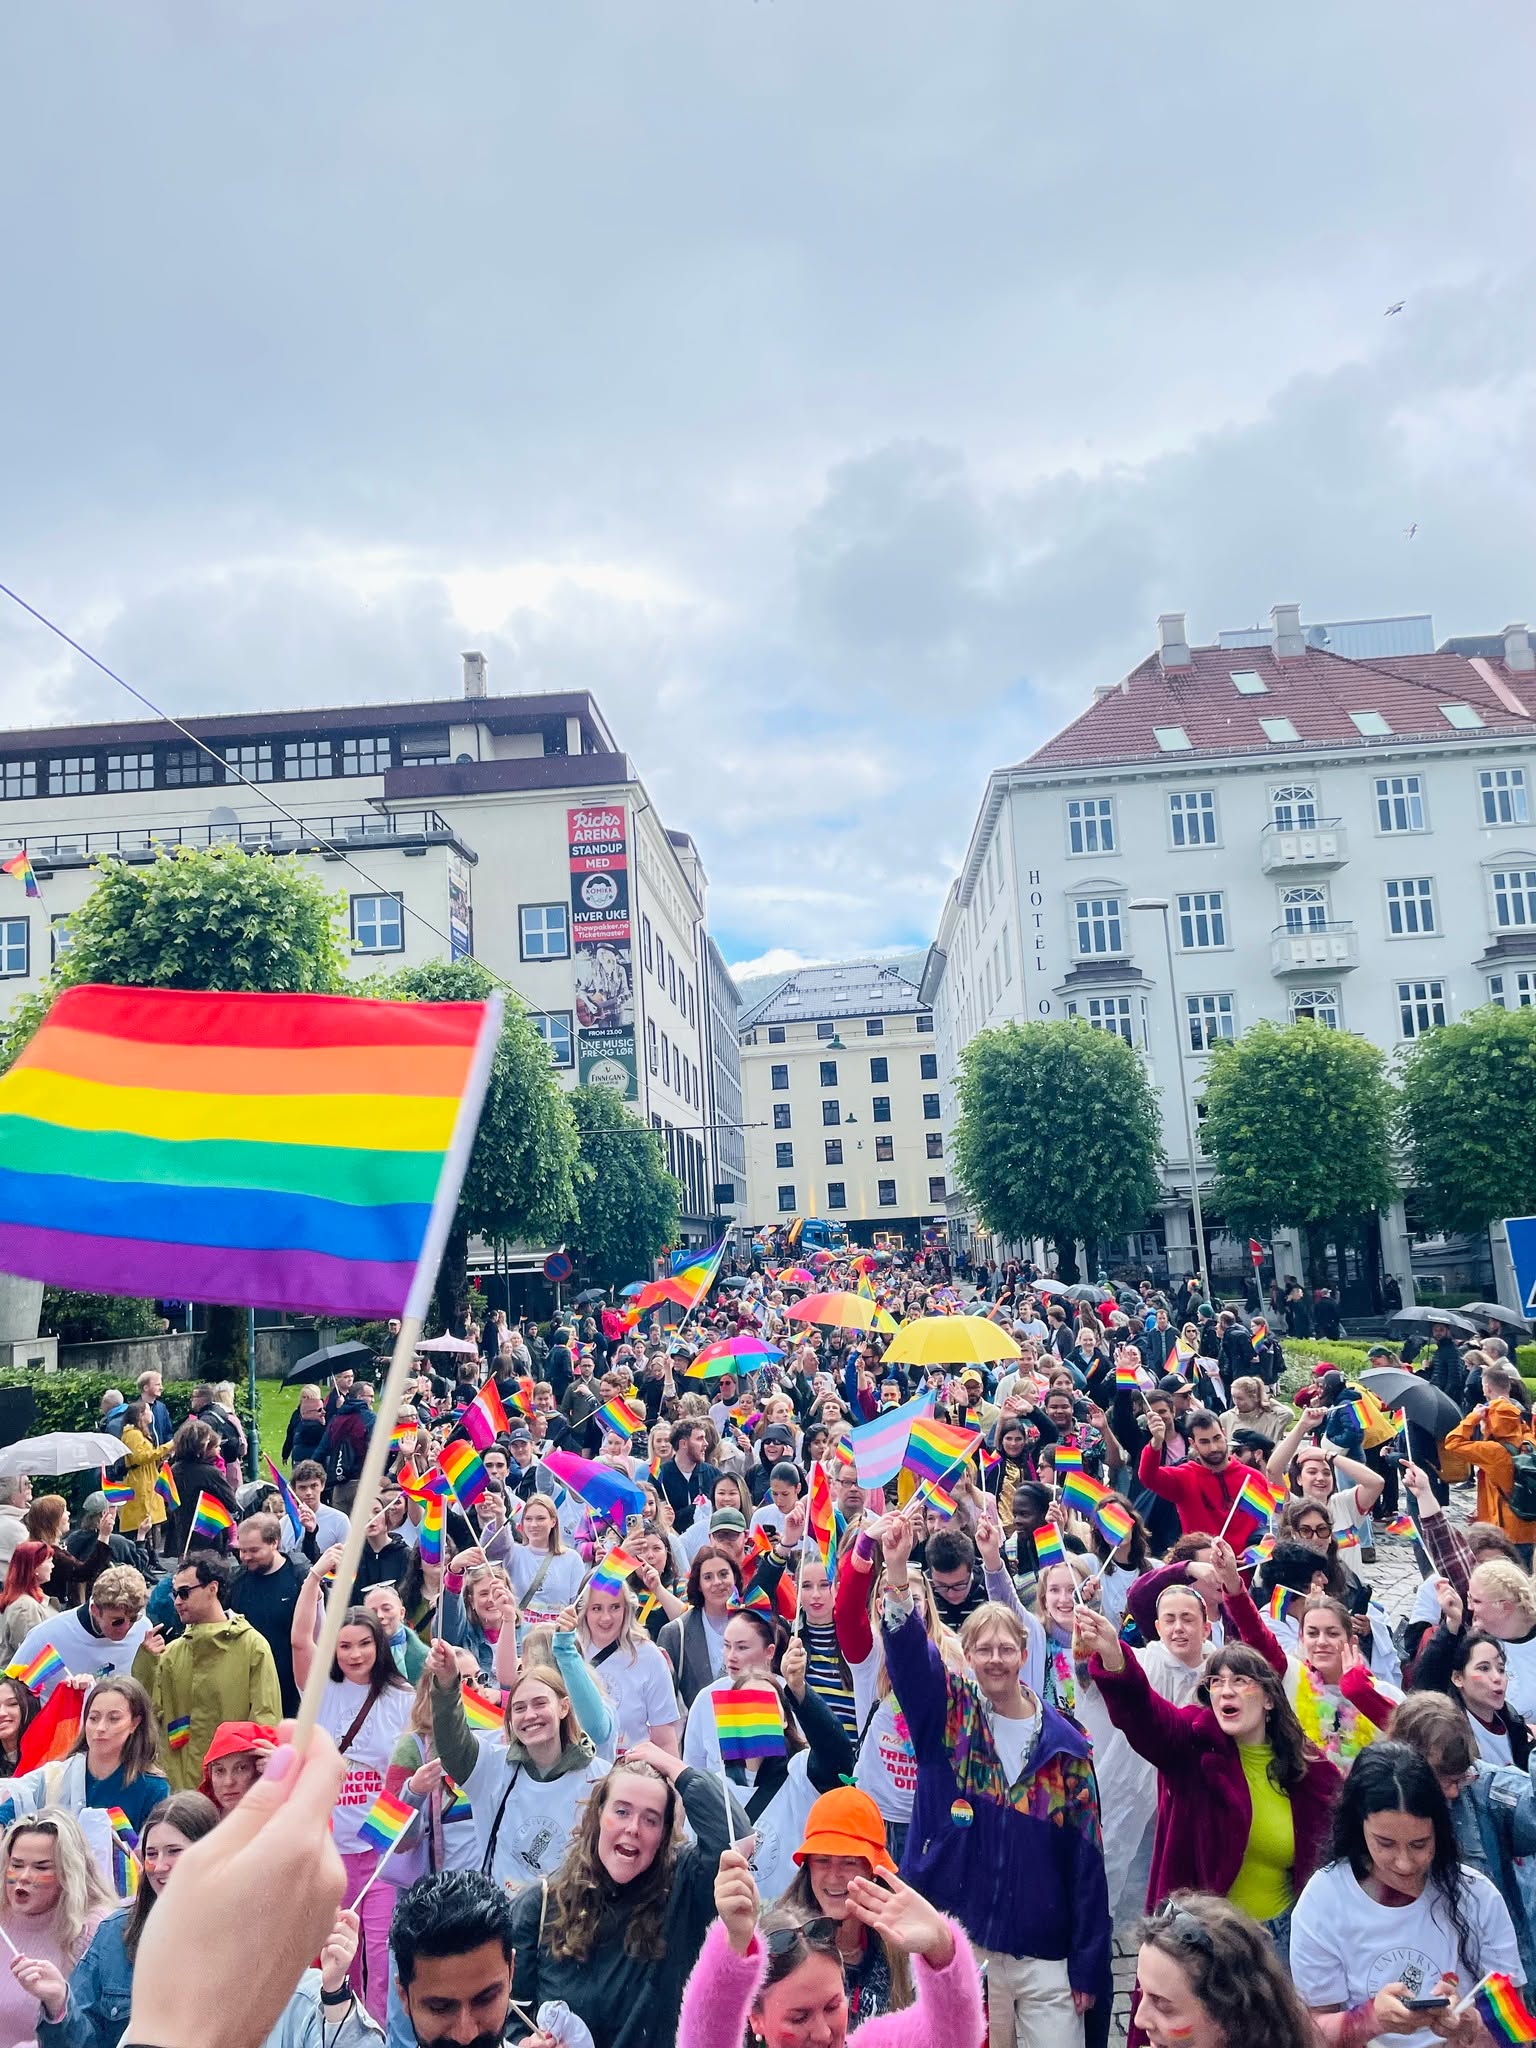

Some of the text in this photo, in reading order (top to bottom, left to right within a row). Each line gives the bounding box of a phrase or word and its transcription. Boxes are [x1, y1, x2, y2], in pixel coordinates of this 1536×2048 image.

[573, 811, 621, 829] Rick's
[574, 828, 621, 841] ARENA
[572, 843, 623, 856] STANDUP
[585, 858, 610, 868] MED
[574, 909, 627, 922] HVER UKE
[1029, 870, 1047, 971] HOTEL
[574, 922, 629, 932] Showpakker.no
[578, 929, 625, 939] Ticketmaster
[581, 1039, 634, 1050] LIVE MUSIC
[600, 1048, 614, 1056] OG
[616, 1047, 633, 1055] LØR
